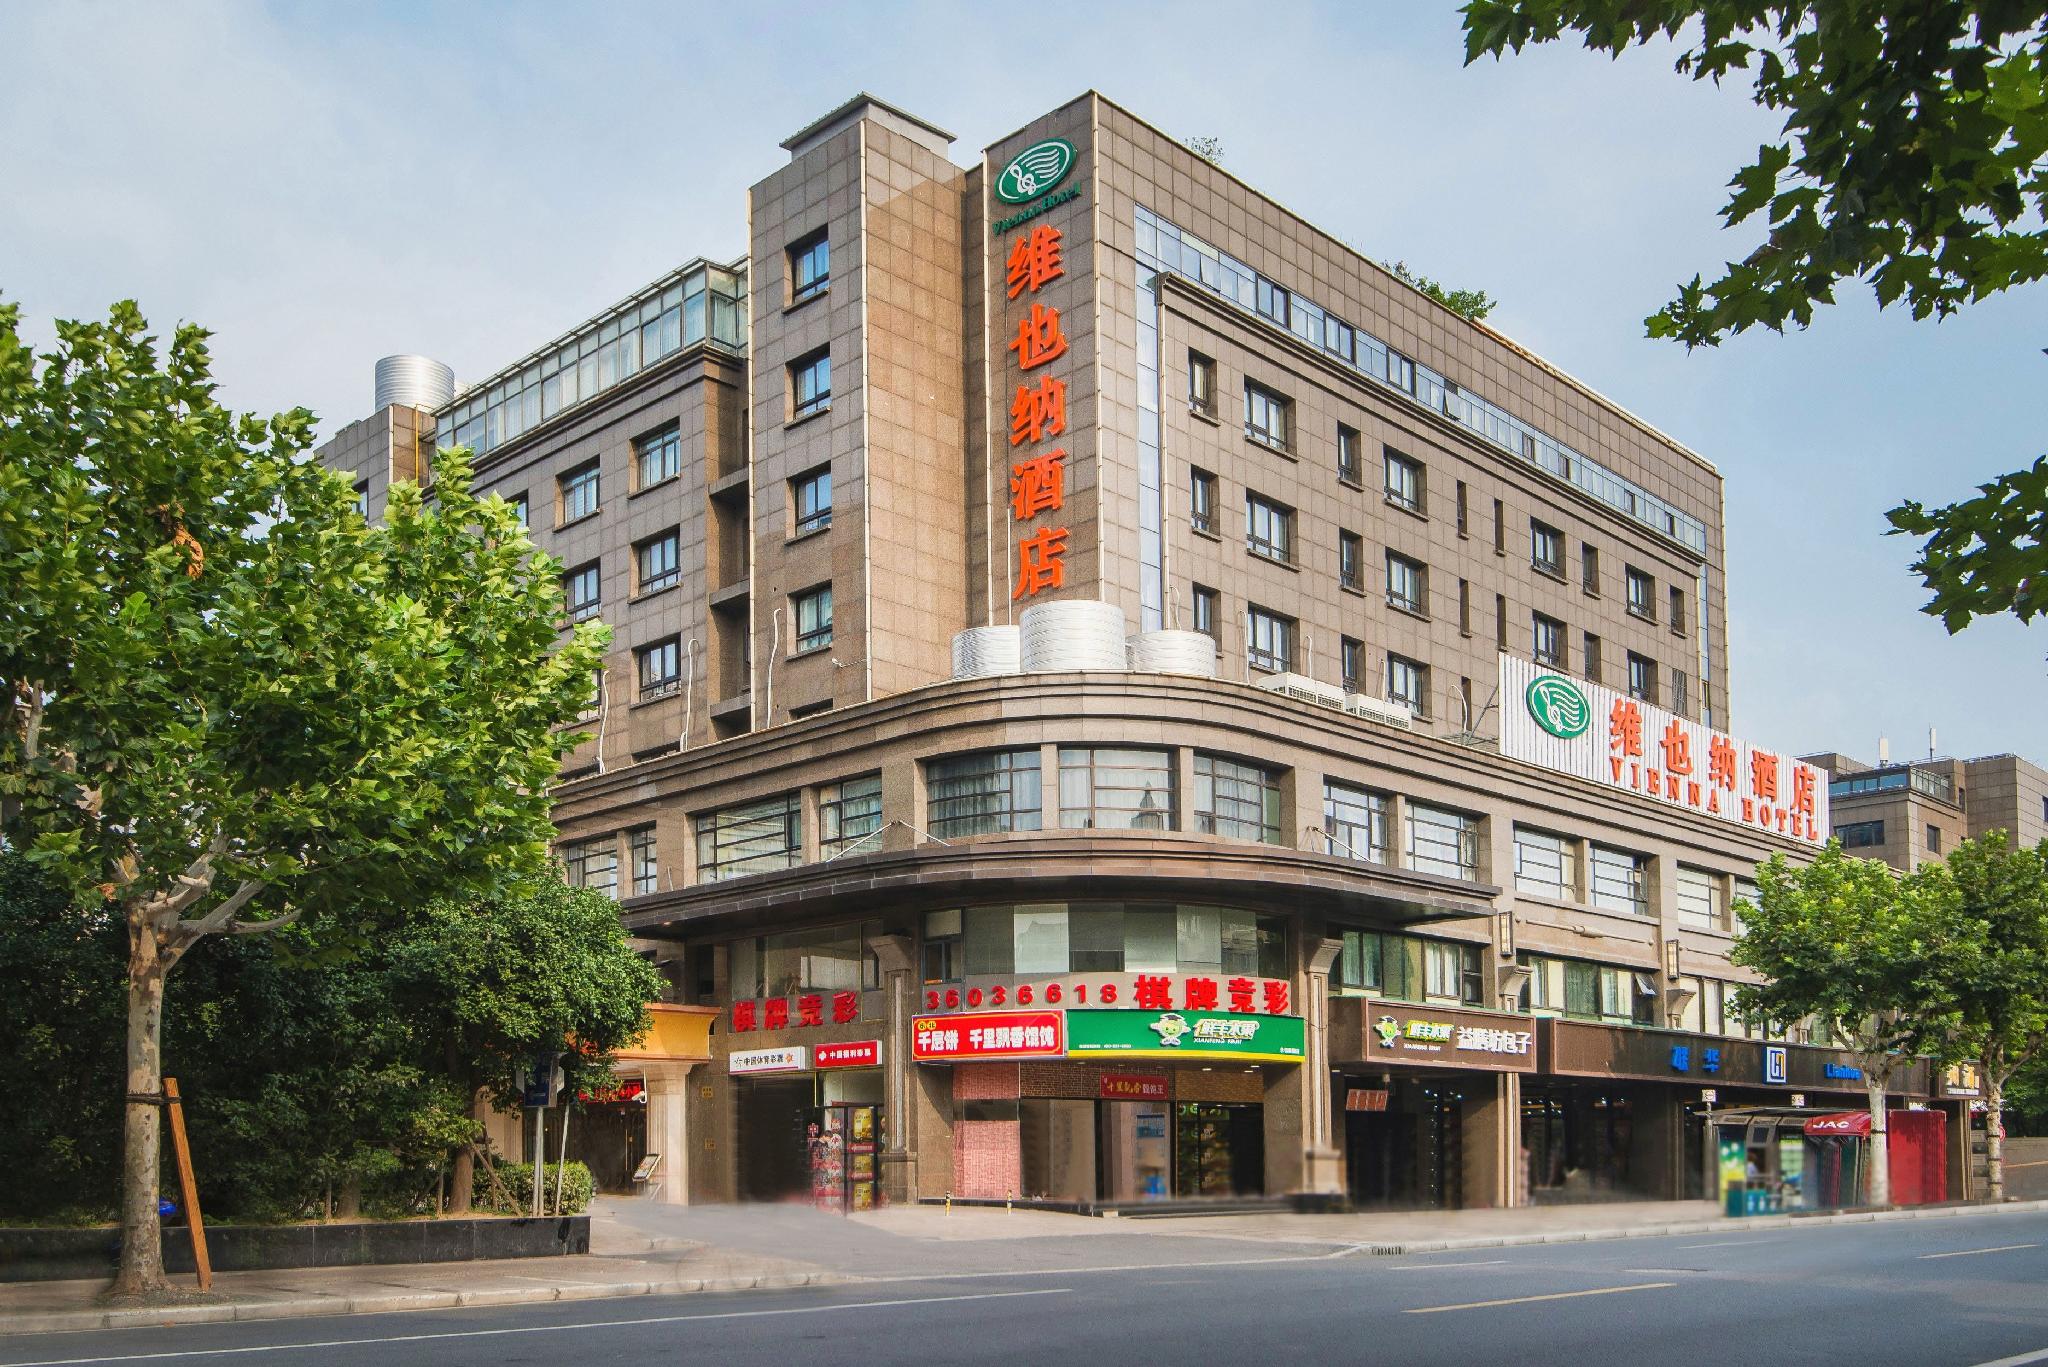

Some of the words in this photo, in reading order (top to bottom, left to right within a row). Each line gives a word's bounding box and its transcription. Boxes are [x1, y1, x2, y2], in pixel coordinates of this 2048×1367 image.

[1007, 223, 1071, 600] 维也纳酒店
[1609, 698, 1816, 816] 维也纳酒店
[1609, 756, 1720, 813] VIENNA
[1741, 798, 1818, 840] HOTEL
[926, 983, 1118, 1009] 36036618
[743, 1052, 784, 1066] 中国体育彩票
[917, 1030, 959, 1051] 千层饼
[969, 1025, 1055, 1050] 千里飘香馄饨
